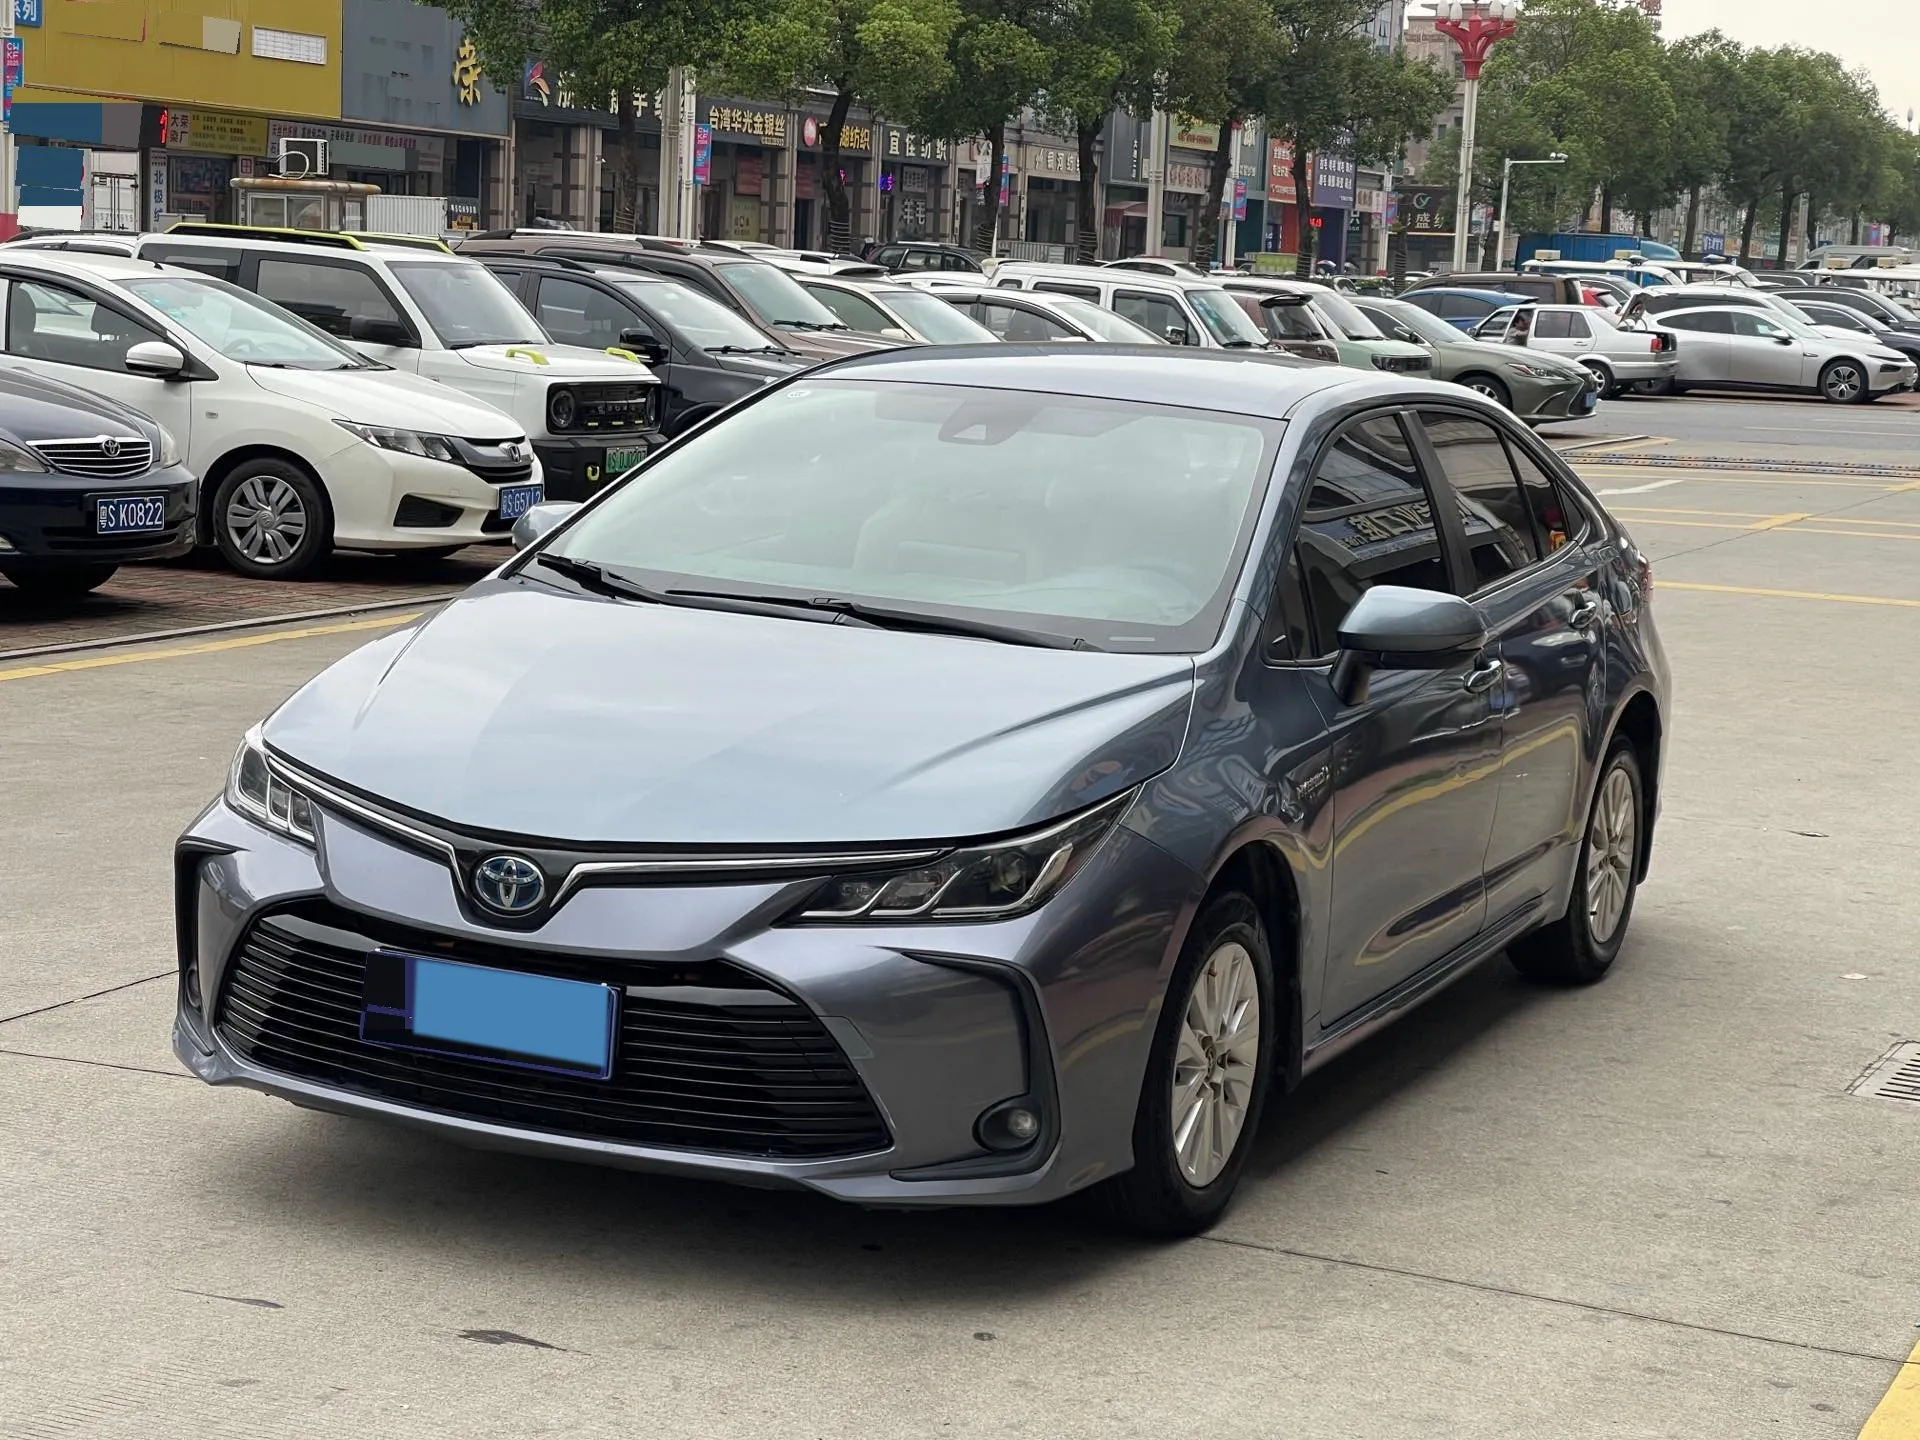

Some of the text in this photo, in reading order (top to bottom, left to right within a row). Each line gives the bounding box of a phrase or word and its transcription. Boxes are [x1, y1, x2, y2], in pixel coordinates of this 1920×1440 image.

[709, 105, 785, 137] 台湾华光金银丝
[903, 199, 926, 225] 羊毛
